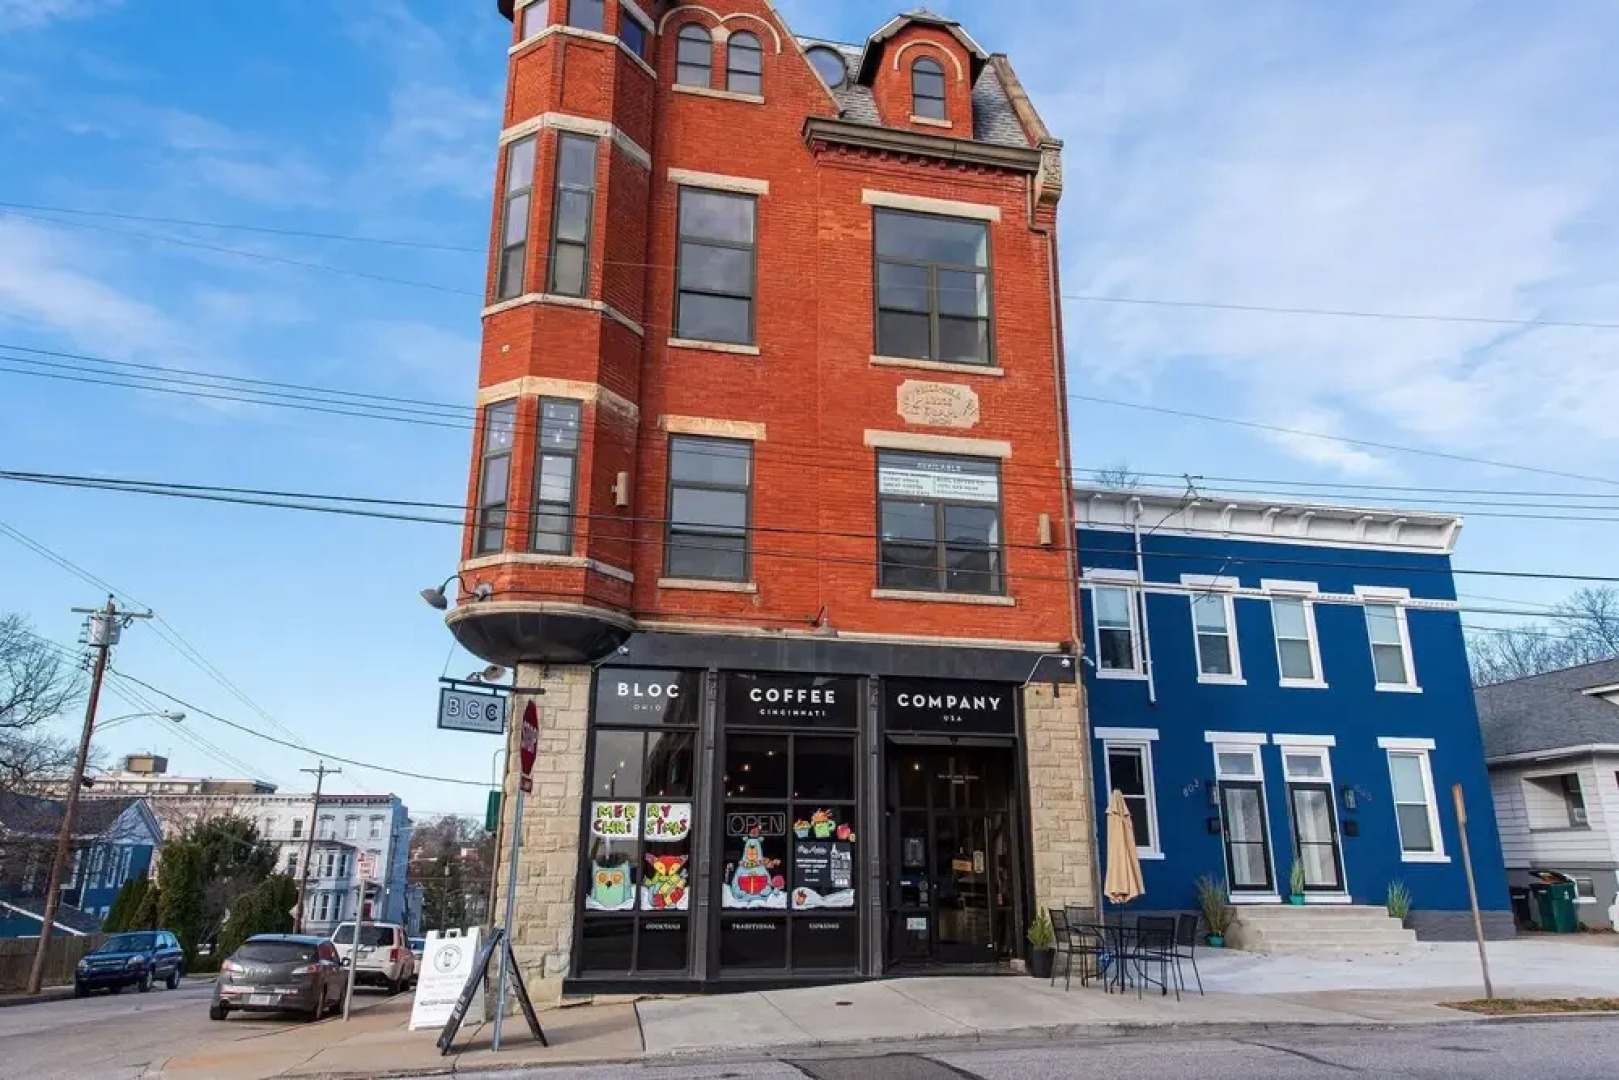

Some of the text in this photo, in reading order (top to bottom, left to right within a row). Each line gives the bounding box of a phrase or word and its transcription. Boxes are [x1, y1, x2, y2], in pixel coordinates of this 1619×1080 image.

[617, 682, 680, 698] BLOC
[750, 687, 836, 703] COFFEE
[897, 694, 1002, 711] COMPANY
[759, 708, 827, 718] CINCINNATI
[731, 815, 783, 833] OPEN
